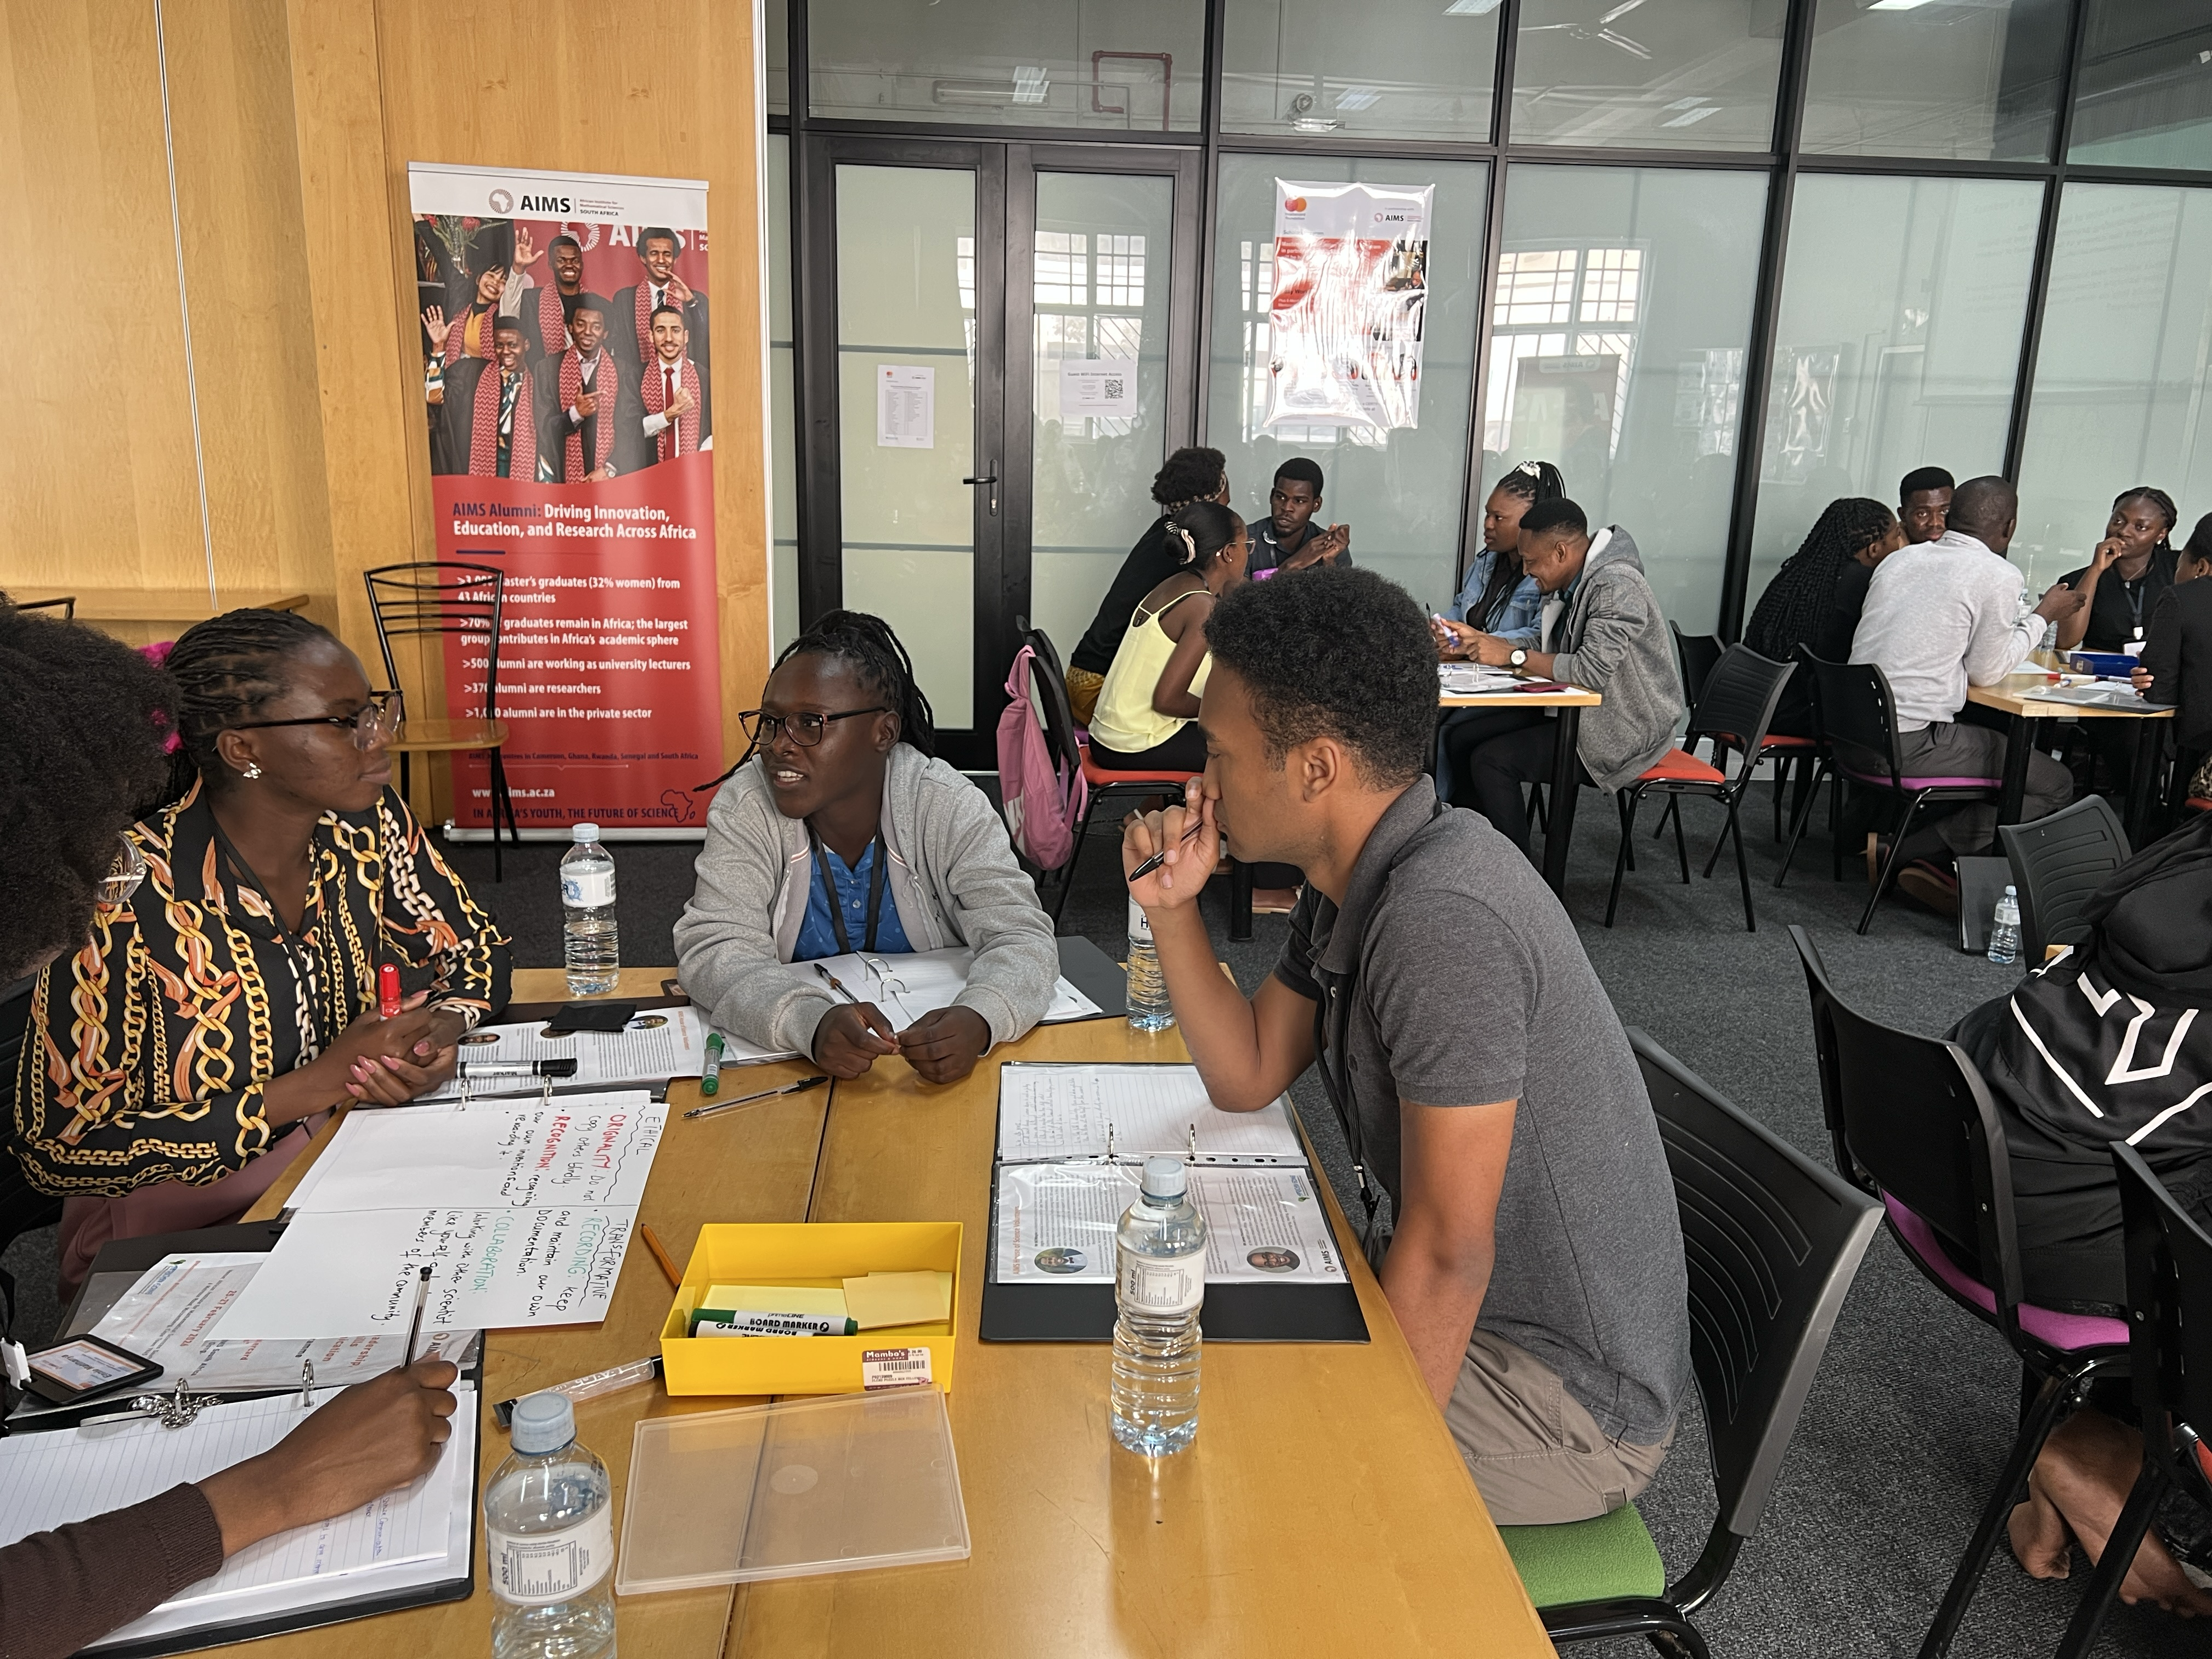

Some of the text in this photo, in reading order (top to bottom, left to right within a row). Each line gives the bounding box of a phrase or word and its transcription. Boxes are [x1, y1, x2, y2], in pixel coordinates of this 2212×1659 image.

[520, 196, 571, 213] AIMS
[608, 224, 686, 249] AIS
[453, 503, 669, 522] AIMS Alumni: Driving Innovation,
[454, 520, 696, 539] Education, and Research Across Africa
[496, 575, 536, 586] aster's
[539, 576, 587, 589] graduates
[589, 577, 614, 589] (32%
[615, 577, 655, 590] women)
[657, 577, 680, 589] from
[472, 591, 507, 602] Africn
[510, 592, 556, 603] countries
[460, 617, 490, 628] >70%
[504, 617, 554, 630] graduates
[556, 617, 590, 629] remain
[591, 618, 601, 629] in
[603, 618, 635, 630] Africa;
[636, 618, 653, 629] the
[655, 618, 688, 632] largest
[461, 635, 490, 646] group
[496, 633, 549, 644] ontributes
[550, 633, 560, 644] in
[599, 634, 645, 645] academic
[646, 634, 679, 647] sphere
[463, 658, 691, 672] >500 lumni are working as university lecturers
[528, 684, 545, 693] are
[547, 682, 601, 694] researchers
[466, 707, 652, 720] >1,0 alumni are in the private sector
[472, 786, 555, 798] ww.ims.ac.za
[473, 809, 483, 818] IN
[530, 808, 566, 820] YOUTH,
[567, 808, 585, 819] THE
[589, 808, 627, 818] FUTURE
[627, 808, 639, 818] OF
[641, 808, 679, 818] SCIENCE
[523, 1130, 535, 1146] own
[636, 1116, 662, 1155] ETHICAL
[589, 1176, 606, 1186] Do
[583, 1190, 595, 1201] not
[555, 1210, 571, 1227] and
[399, 1248, 422, 1258] of
[543, 1232, 563, 1266] maintain
[1321, 1250, 1333, 1265] AIMS
[1130, 1268, 1136, 1279] ml
[537, 1274, 548, 1290] our
[191, 1306, 222, 1332] February
[750, 1318, 818, 1330] BOARD MARKER
[727, 1324, 764, 1333] MARKER
[349, 1336, 366, 1347] ills
[240, 1340, 263, 1361] ercard
[322, 1337, 348, 1362] ication
[348, 1335, 382, 1368] adership,
[866, 1350, 905, 1358] Mambo's
